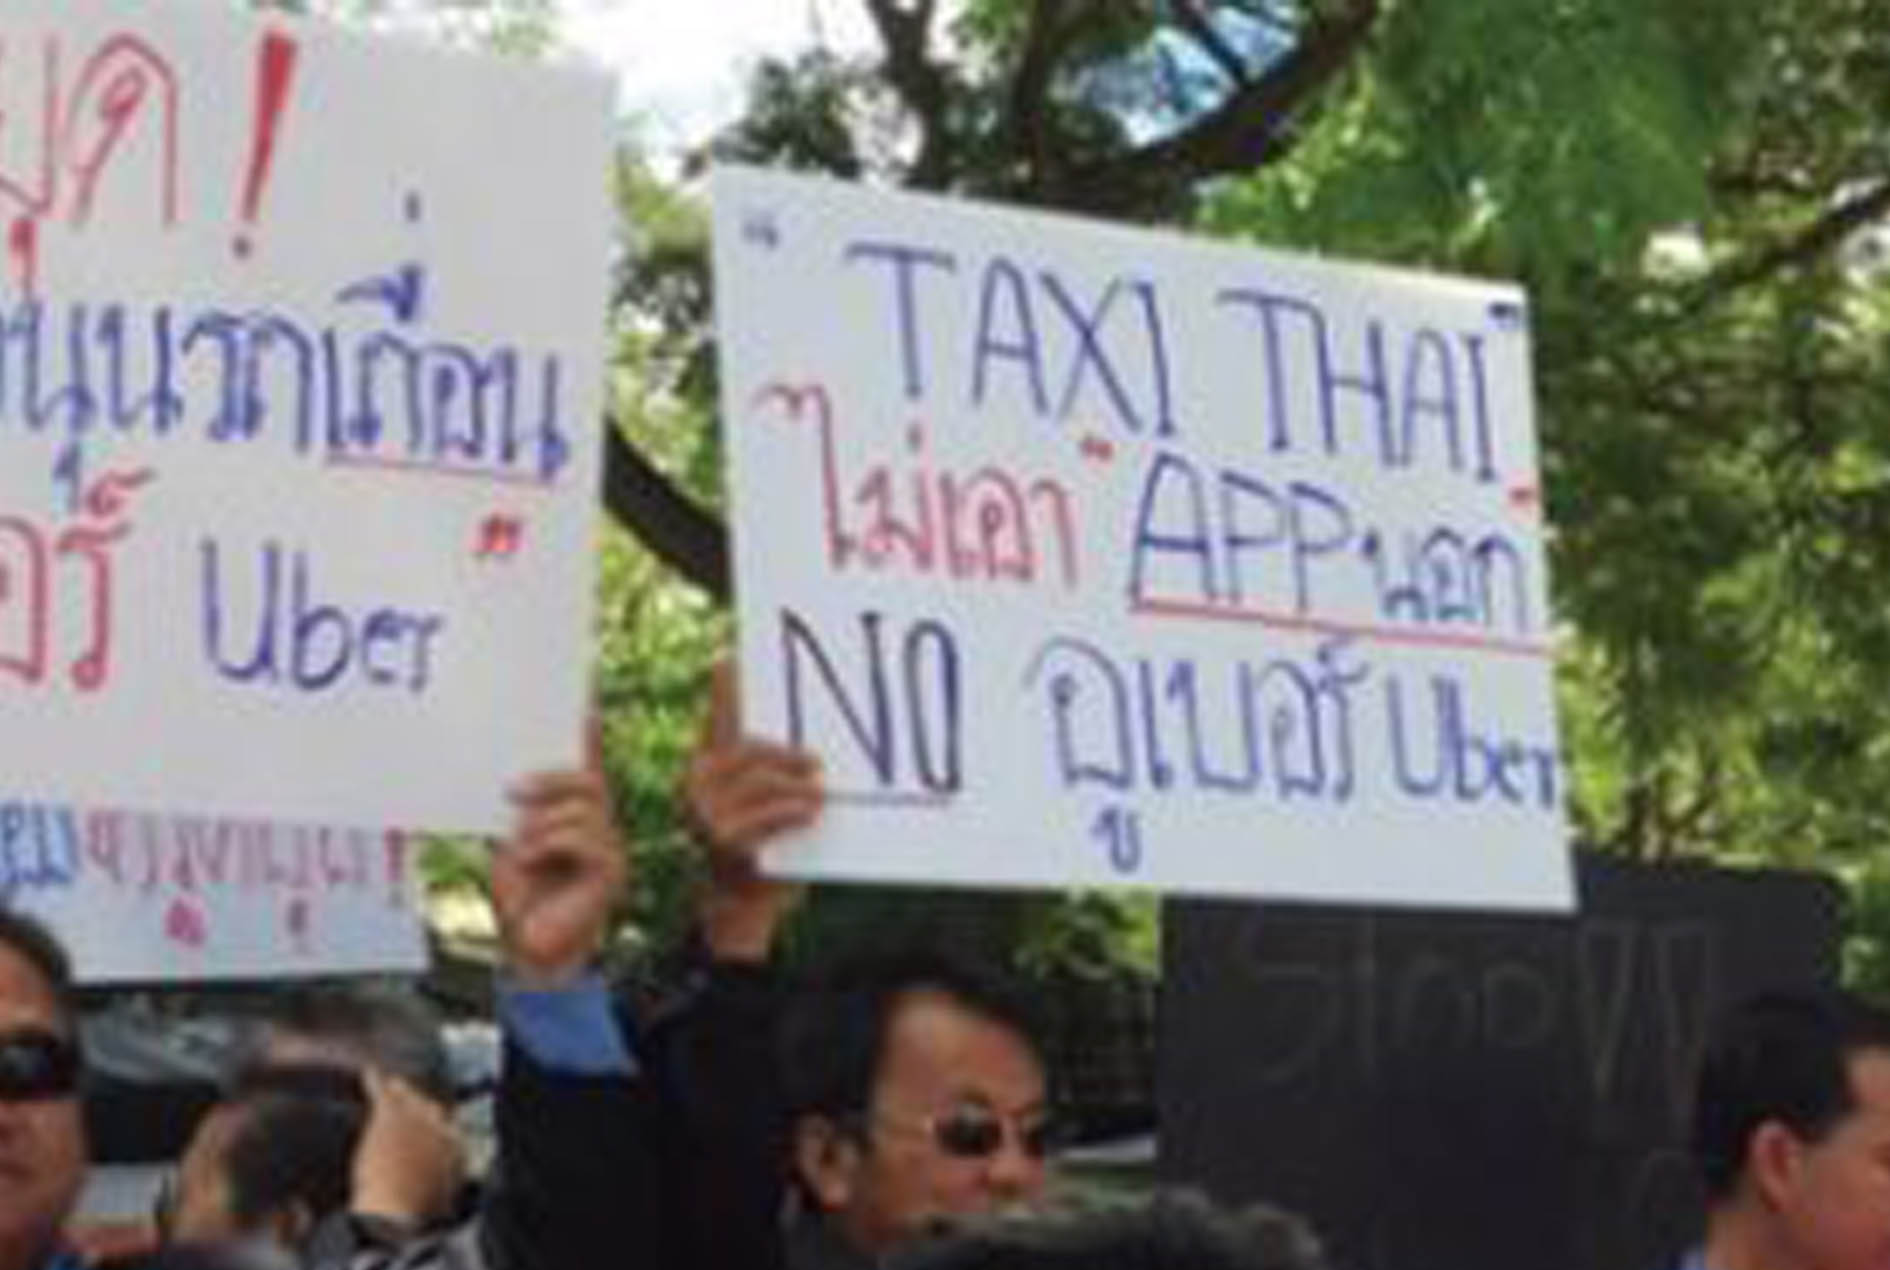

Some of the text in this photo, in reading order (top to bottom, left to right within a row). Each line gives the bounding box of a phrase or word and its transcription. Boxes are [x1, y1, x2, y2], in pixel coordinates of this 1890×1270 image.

[845, 242, 1496, 482] TAXI THAI
[780, 608, 963, 797] NO
